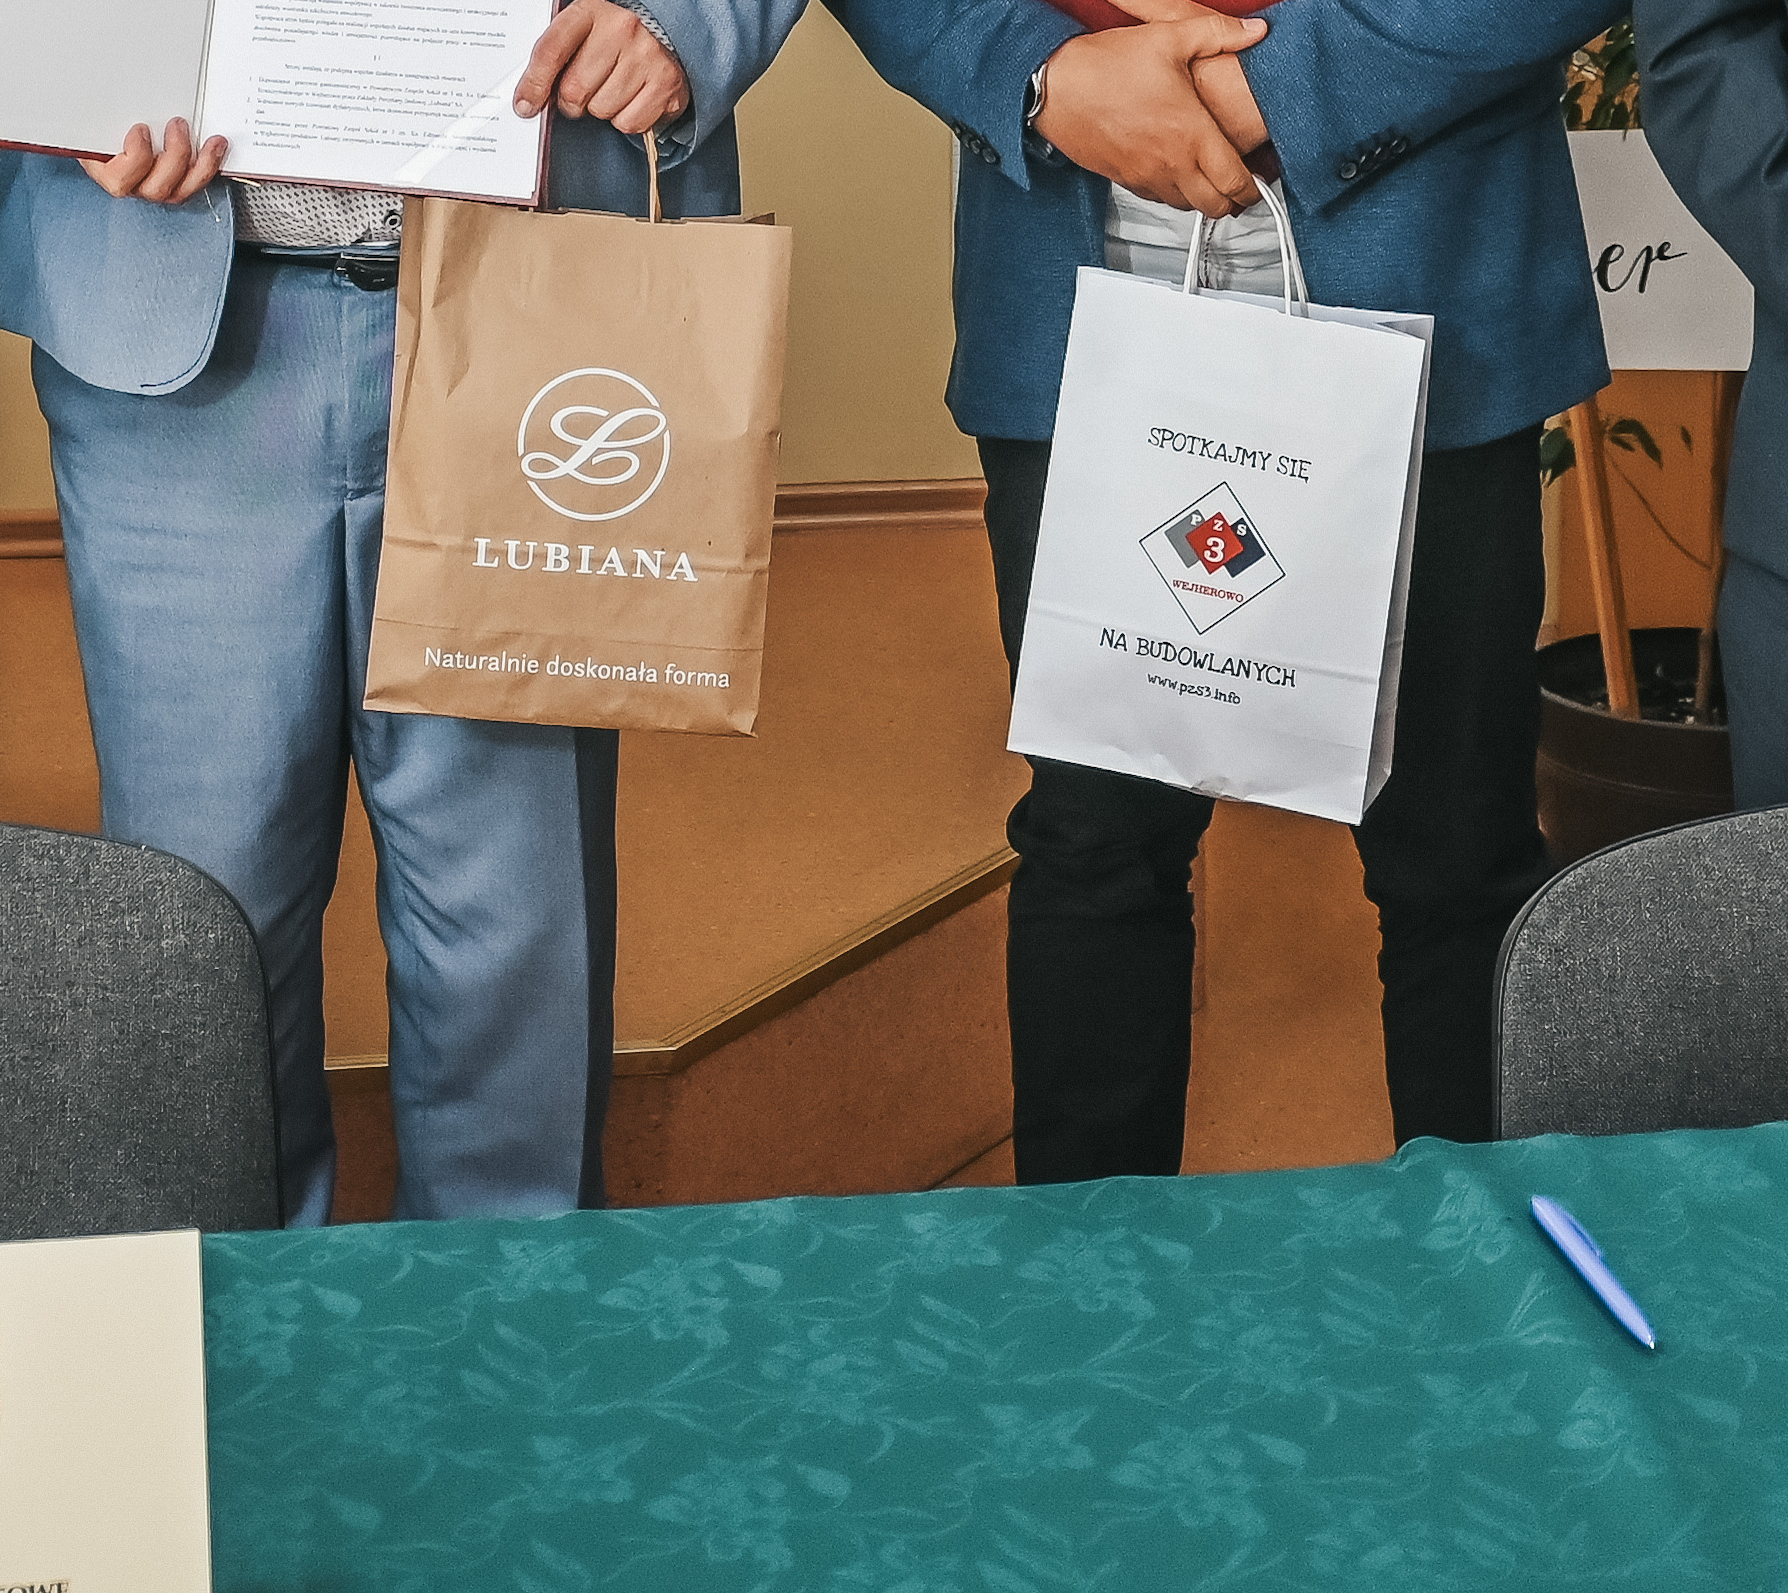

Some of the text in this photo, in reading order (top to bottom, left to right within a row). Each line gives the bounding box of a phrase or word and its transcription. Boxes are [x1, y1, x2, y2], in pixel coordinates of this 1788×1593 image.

[1147, 426, 1312, 484] SPOTKAJMY SIĘ
[1190, 514, 1247, 537] P Z S
[472, 537, 698, 583] LUBIANA
[1203, 537, 1225, 563] 3
[1172, 579, 1244, 603] WEJHEROWO
[423, 646, 731, 690] Naturalnie doskonała forma
[1099, 626, 1297, 688] NA BUDOWLANYCH
[1146, 672, 1242, 707] www.pzs3.info
